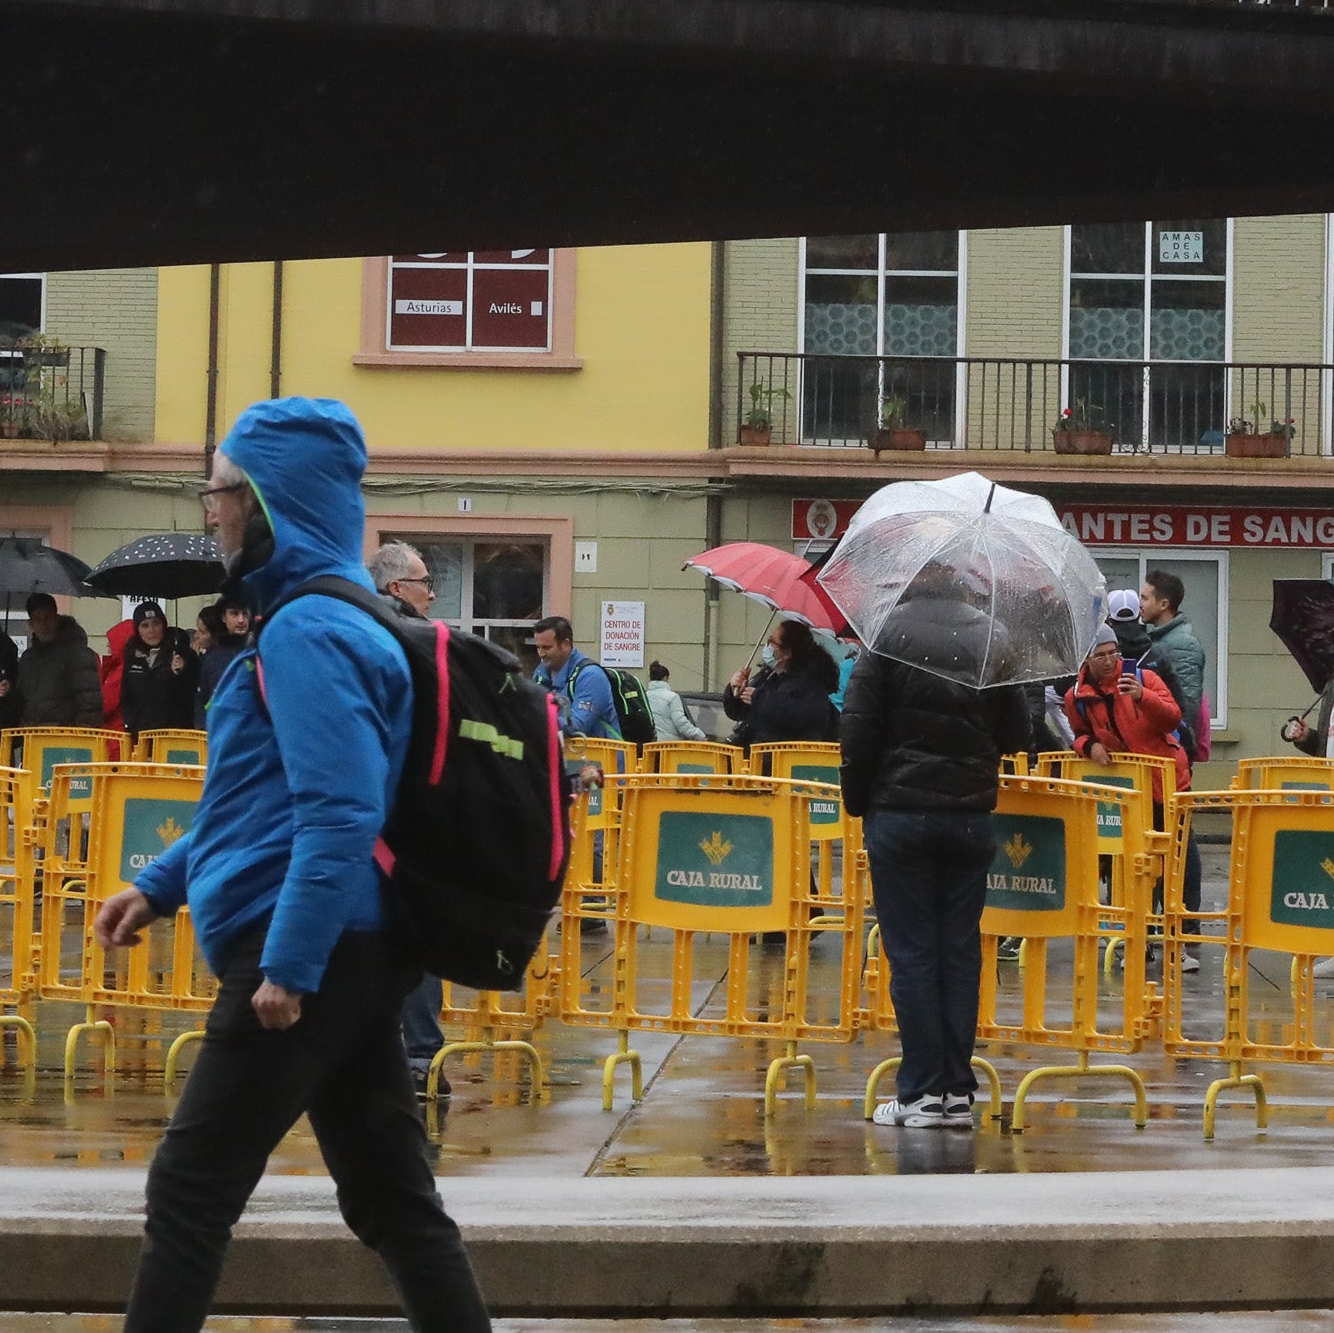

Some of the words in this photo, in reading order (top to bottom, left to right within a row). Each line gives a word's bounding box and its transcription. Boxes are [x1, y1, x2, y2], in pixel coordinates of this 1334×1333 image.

[1162, 233, 1201, 241] AMAS
[1173, 242, 1190, 250] DE
[1162, 251, 1200, 260] CASA
[406, 301, 452, 314] Asturias
[488, 302, 522, 314] Avilés
[1062, 511, 1173, 542] ANTES
[1186, 514, 1230, 542] DE
[604, 620, 631, 629] CENTRO
[632, 620, 641, 629] DE
[605, 631, 640, 640] DONACIÓN
[604, 642, 613, 651] DE
[614, 642, 641, 651] SANGRE
[69, 780, 88, 790] URAL
[813, 802, 836, 814] RURAL
[667, 870, 706, 888] CAJA
[709, 872, 763, 891] RURAL
[986, 873, 1008, 891] AJA
[1011, 875, 1057, 894] RURAL
[1283, 892, 1330, 910] CAJA
